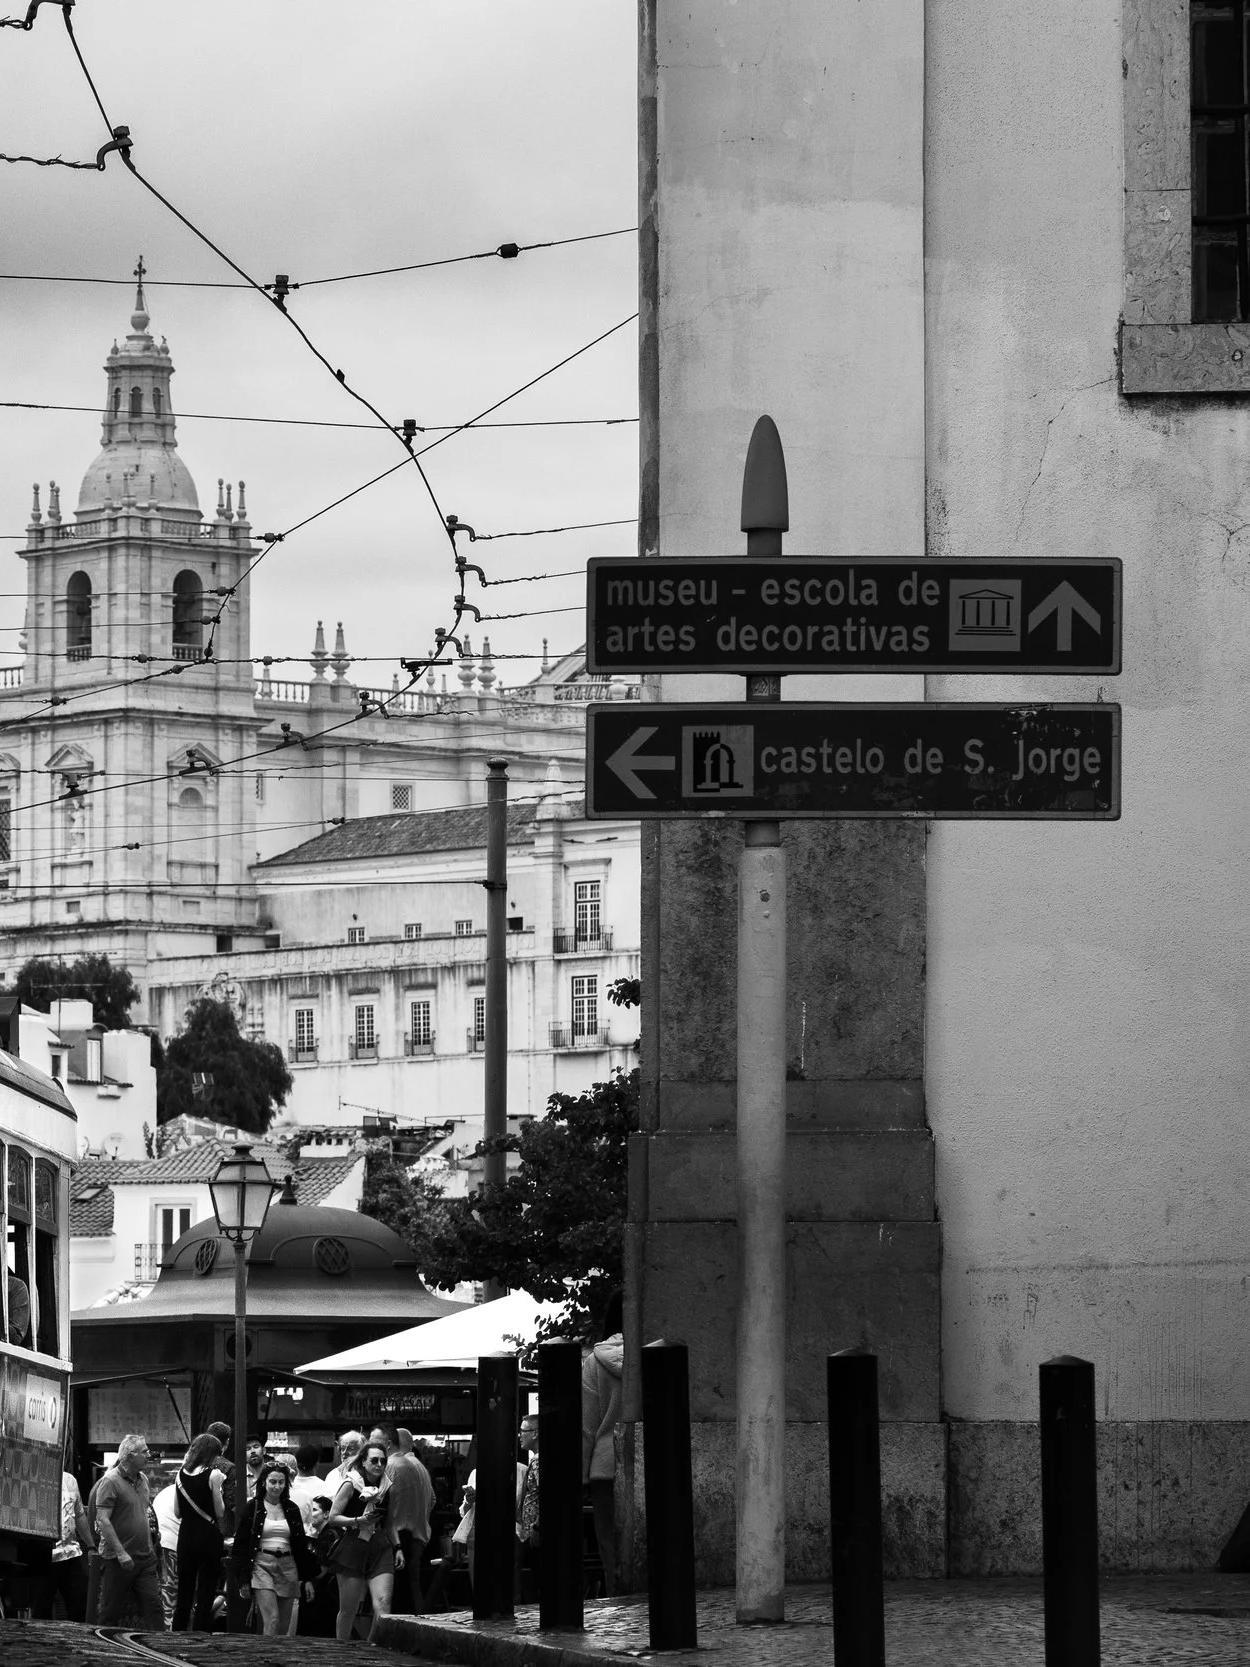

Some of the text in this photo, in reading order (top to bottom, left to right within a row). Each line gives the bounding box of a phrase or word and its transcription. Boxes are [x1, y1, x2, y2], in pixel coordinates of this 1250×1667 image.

[606, 578, 718, 606] museu
[761, 569, 879, 606] escola
[898, 571, 941, 606] de
[606, 616, 930, 652] artes decorativas
[761, 738, 884, 774] castelo
[904, 738, 944, 774] de
[964, 738, 995, 775] S.
[28, 1396, 47, 1423] carris
